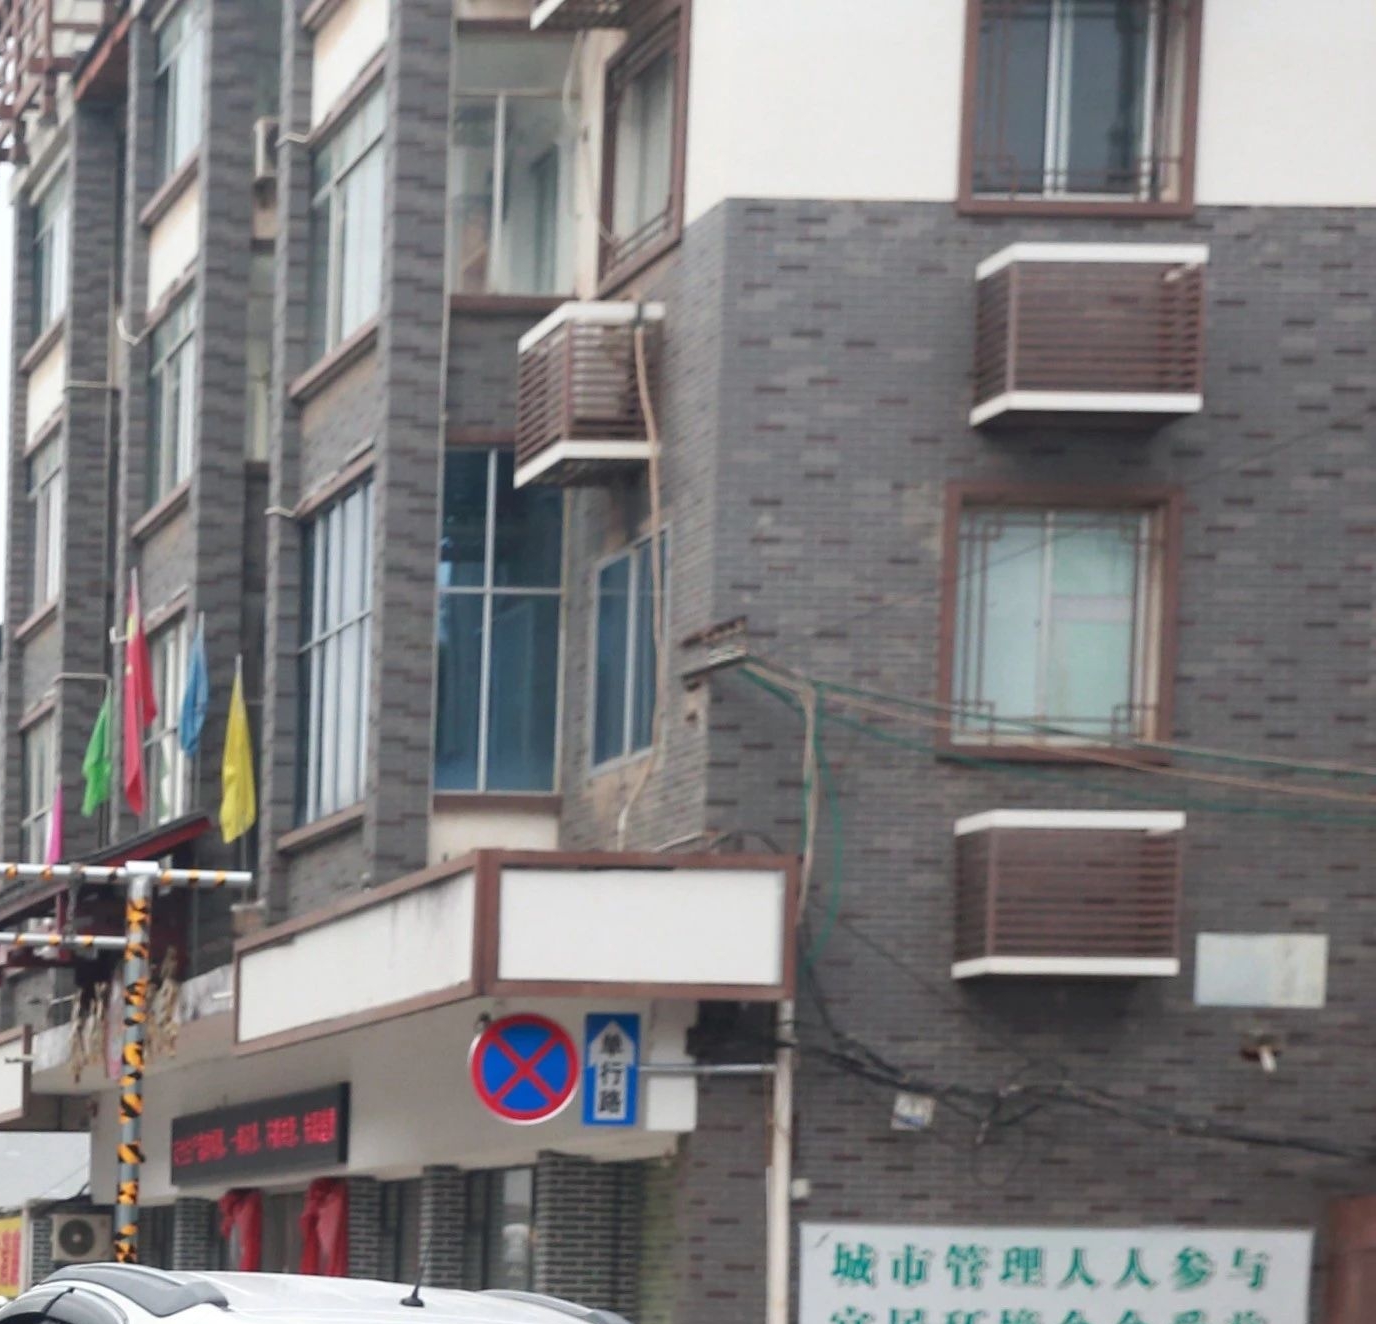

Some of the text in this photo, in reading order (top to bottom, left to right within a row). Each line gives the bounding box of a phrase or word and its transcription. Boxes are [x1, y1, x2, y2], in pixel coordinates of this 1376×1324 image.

[600, 1033, 624, 1113] 单行路
[830, 1242, 1270, 1290] 城市管理人人参与
